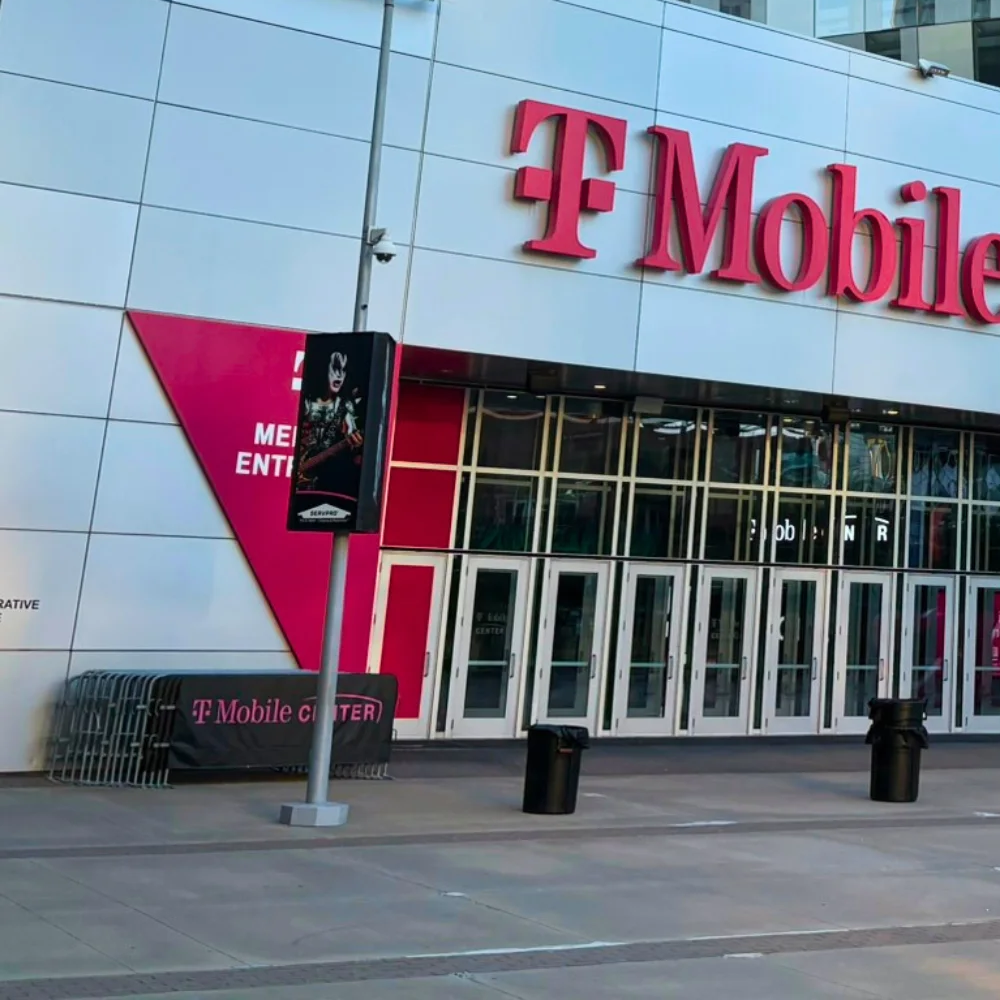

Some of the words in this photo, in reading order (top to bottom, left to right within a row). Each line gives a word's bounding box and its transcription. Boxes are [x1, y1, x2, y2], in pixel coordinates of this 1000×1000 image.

[511, 99, 627, 259] T
[254, 422, 297, 448] ME
[192, 699, 212, 724] T
[215, 698, 292, 724] Mobile
[298, 703, 375, 723] CTER
